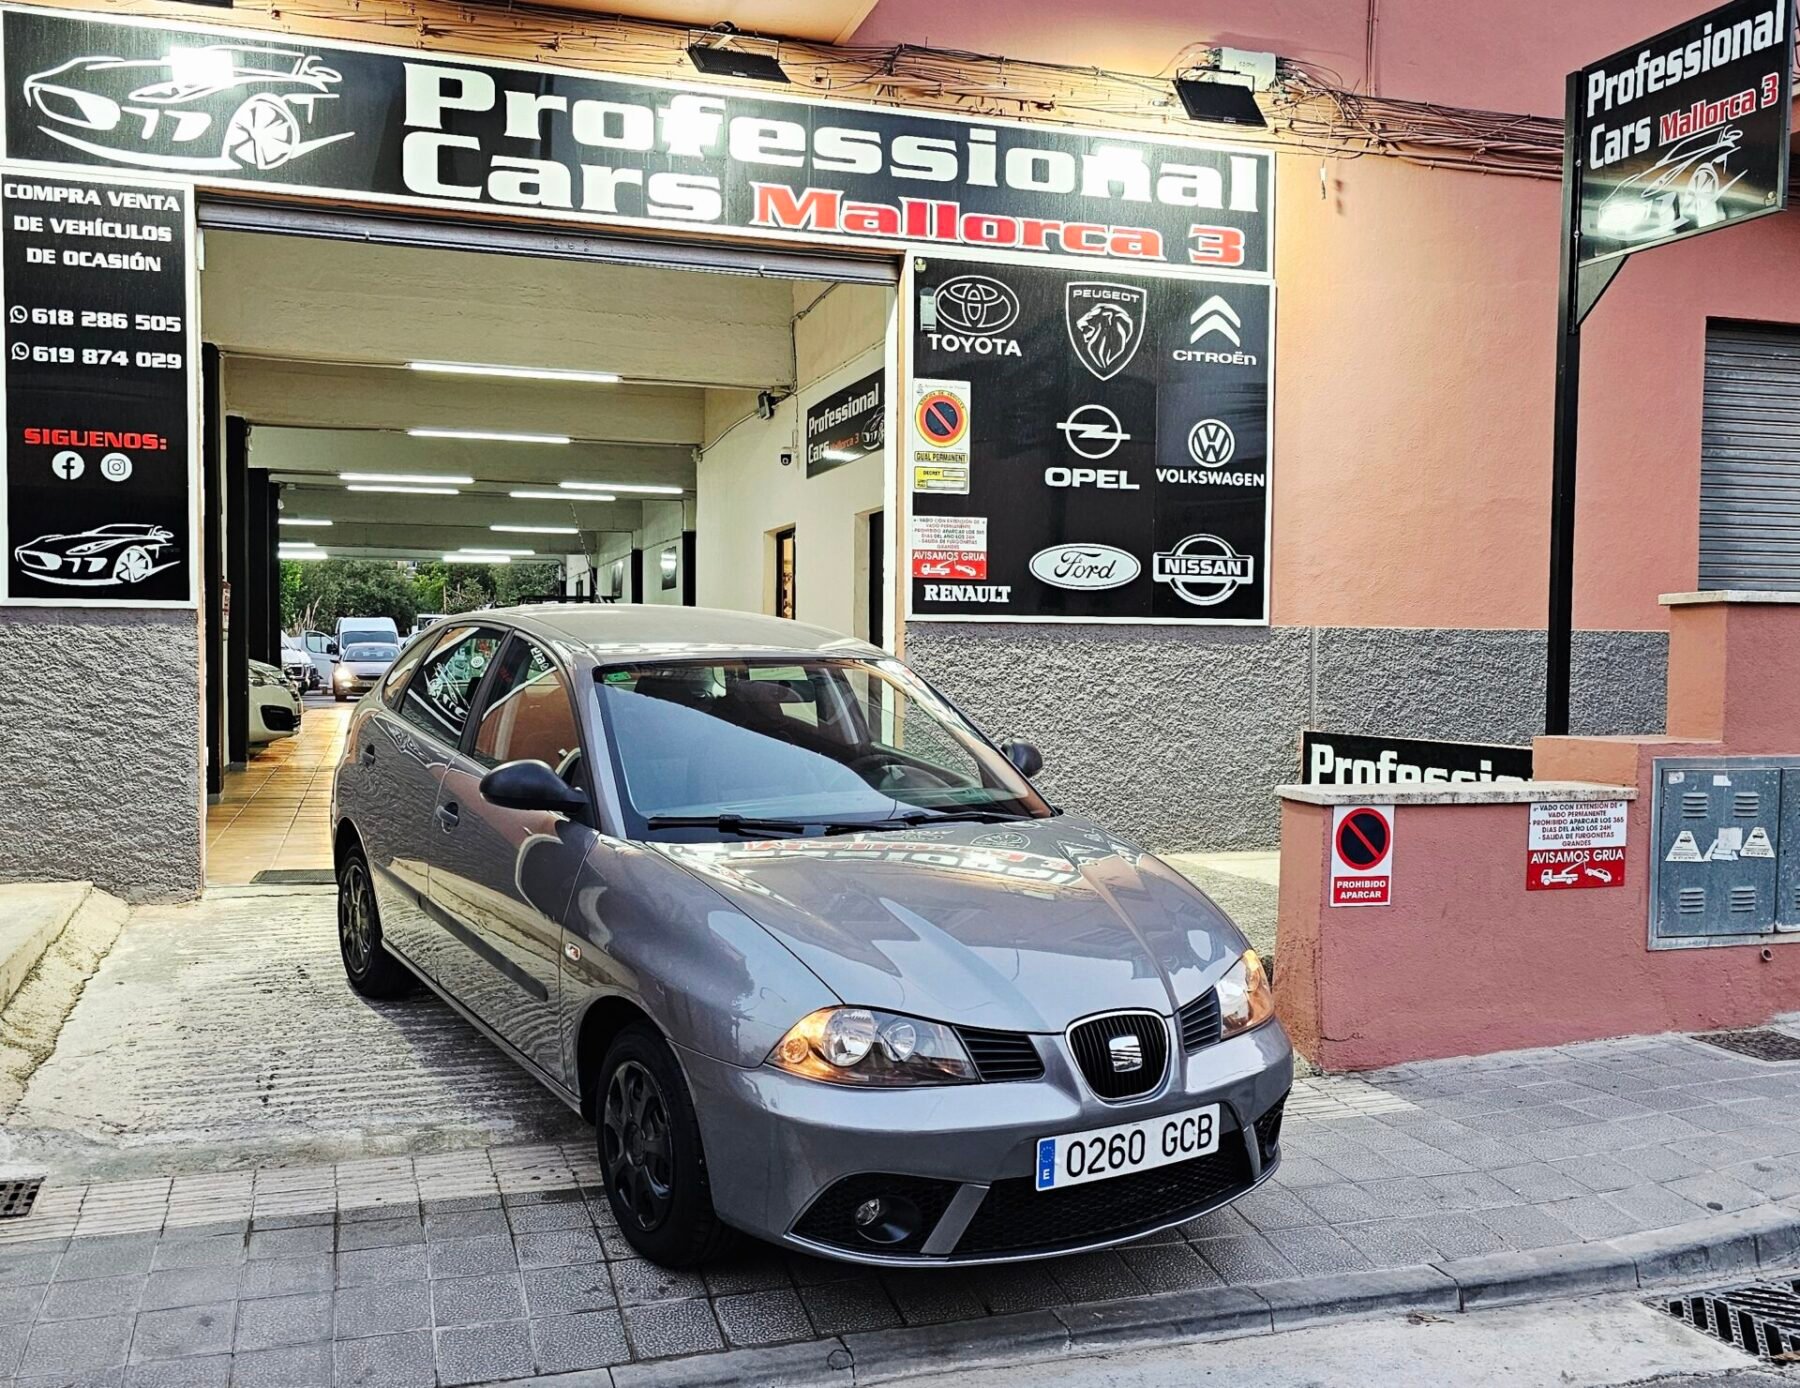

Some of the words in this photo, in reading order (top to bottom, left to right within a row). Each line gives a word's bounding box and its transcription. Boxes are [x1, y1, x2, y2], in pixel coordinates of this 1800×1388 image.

[1587, 0, 1785, 118] Professional
[1589, 116, 1651, 170] Cars
[1658, 87, 1756, 146] Mallorca
[1761, 72, 1779, 109] 3
[403, 61, 1259, 213] Professional
[4, 183, 102, 206] COMPRA
[107, 191, 181, 211] VENTA
[402, 130, 723, 221] Cars
[749, 181, 1167, 261] Mallorca
[1188, 223, 1246, 266] 3
[14, 215, 44, 232] DE
[50, 217, 172, 242] VEHÍCULOS
[26, 247, 56, 264] DE
[63, 250, 161, 272] OCASIÓN
[1072, 289, 1140, 303] PEUGEOT
[32, 308, 74, 325] 618
[81, 310, 128, 329] 286
[135, 314, 181, 332] 505
[32, 345, 74, 363] 619
[82, 348, 129, 366] 874
[136, 351, 182, 369] 029
[927, 333, 1022, 357] TOYOTA
[808, 382, 880, 438] Professional
[24, 427, 167, 450] SIGUENOS:
[1044, 466, 1140, 490] OPEL
[1155, 468, 1265, 487] VOLKSWAGEN
[913, 551, 959, 560] AVISAMOS
[960, 552, 985, 561] GRUA
[1053, 550, 1117, 579] Ford
[1164, 558, 1242, 576] NISSAN
[923, 584, 1011, 603] RENAULT
[1560, 803, 1575, 811] CON
[1530, 850, 1590, 864] AVISAMOS
[1593, 849, 1624, 861] GRUA
[1336, 880, 1386, 889] PROHIBIDO
[1340, 890, 1382, 899] APARCAR
[1066, 1129, 1146, 1177] 0260
[1162, 1113, 1213, 1157] GCB
[1043, 1168, 1050, 1180] E
